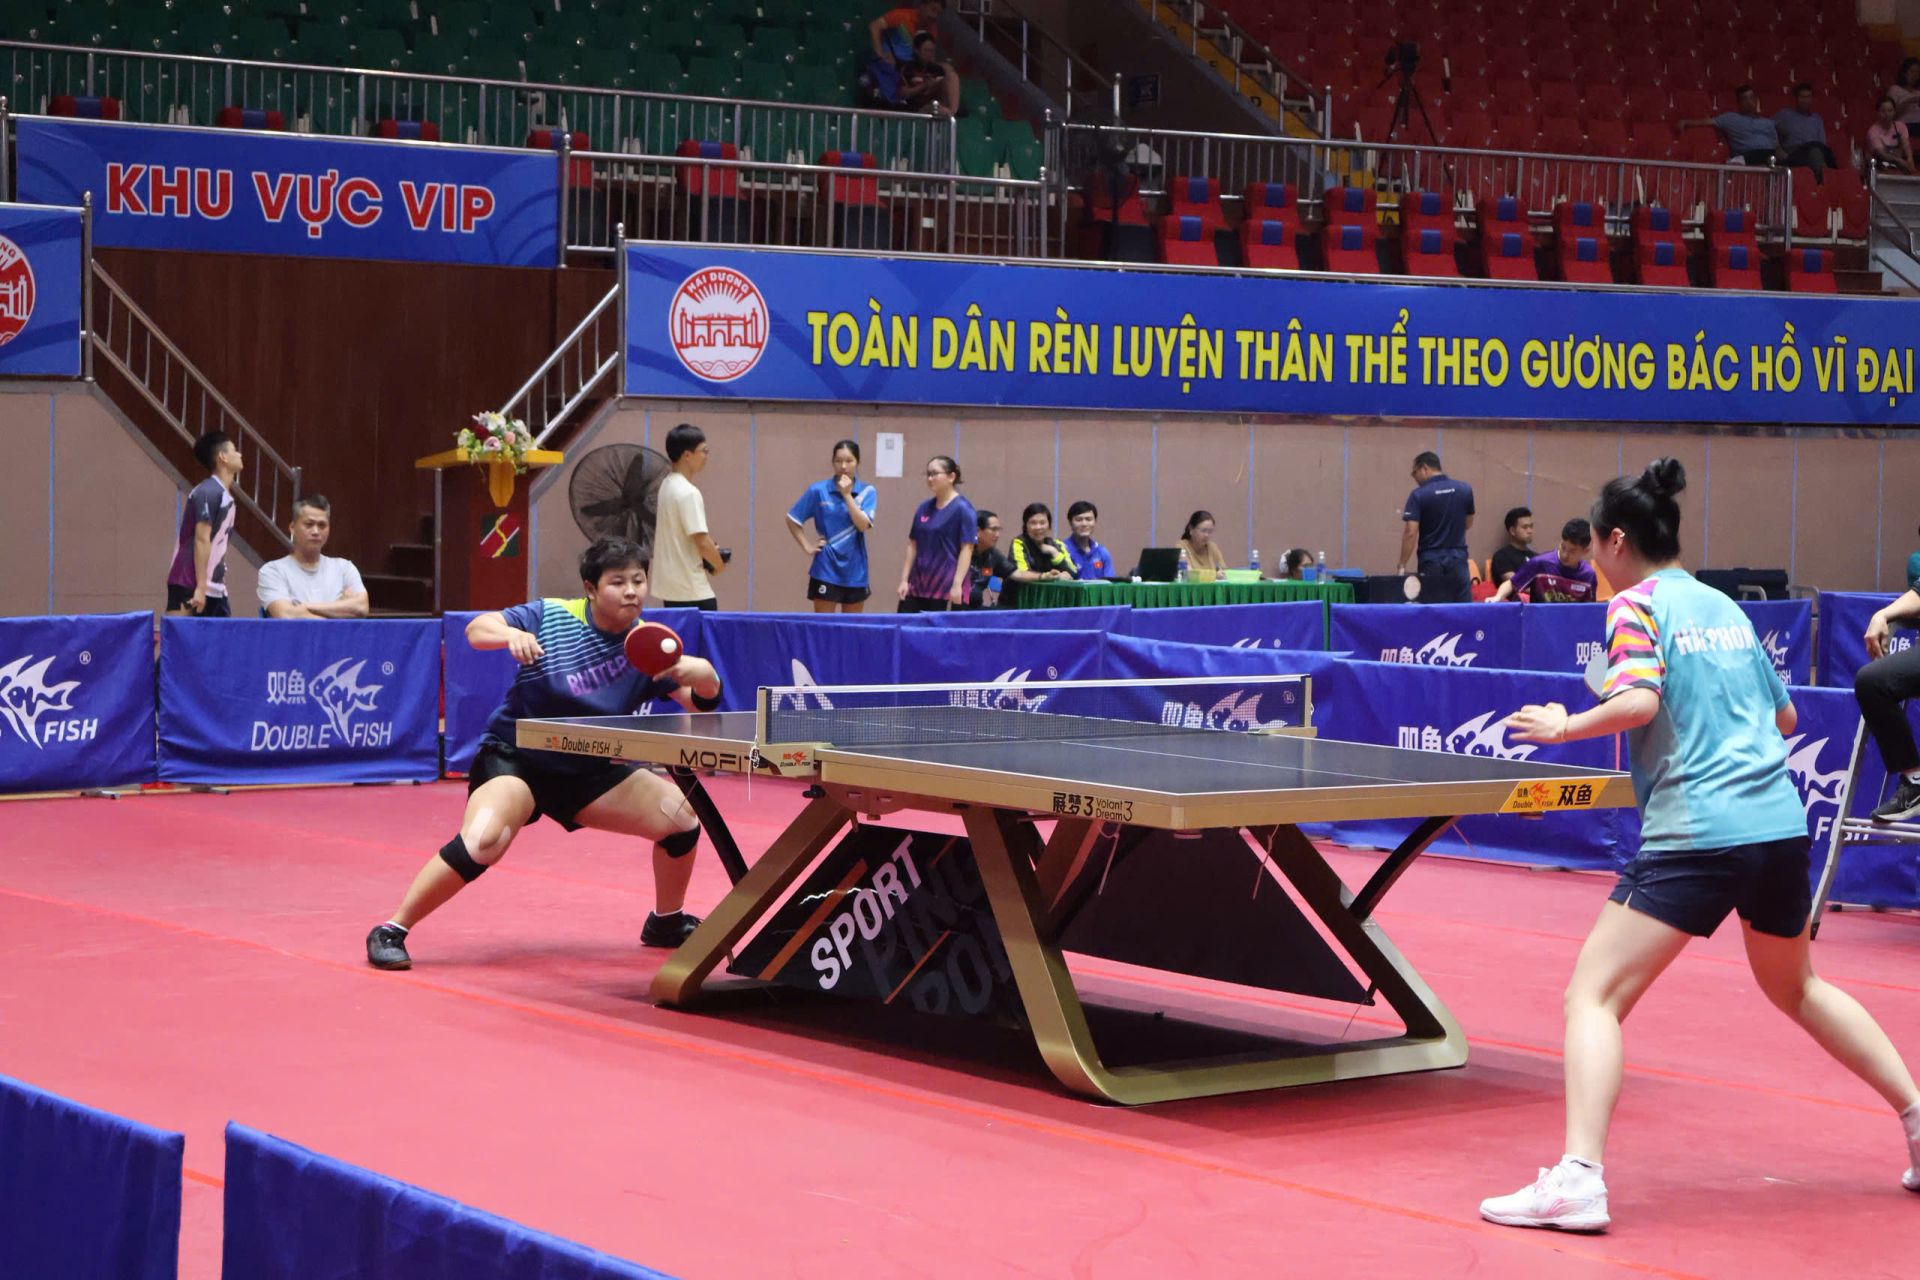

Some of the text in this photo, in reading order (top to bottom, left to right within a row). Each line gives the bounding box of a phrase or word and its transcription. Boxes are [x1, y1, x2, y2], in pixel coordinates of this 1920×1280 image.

[106, 163, 495, 239] KHU VỰC VIP
[807, 297, 1914, 407] TOÀN DÂN RÈN LUYỆN THÂN THỂ THEO GƯƠNG BÁC HỒ VĨ ĐẠI
[1704, 619, 1755, 652] PHÒN
[566, 655, 628, 696] BUTTER
[43, 718, 99, 744] FISH
[250, 720, 393, 752] DOUBLE FISH
[561, 736, 591, 753] Double
[591, 741, 611, 754] FISH
[1095, 807, 1123, 821] Dream
[810, 834, 922, 990] SPORT
